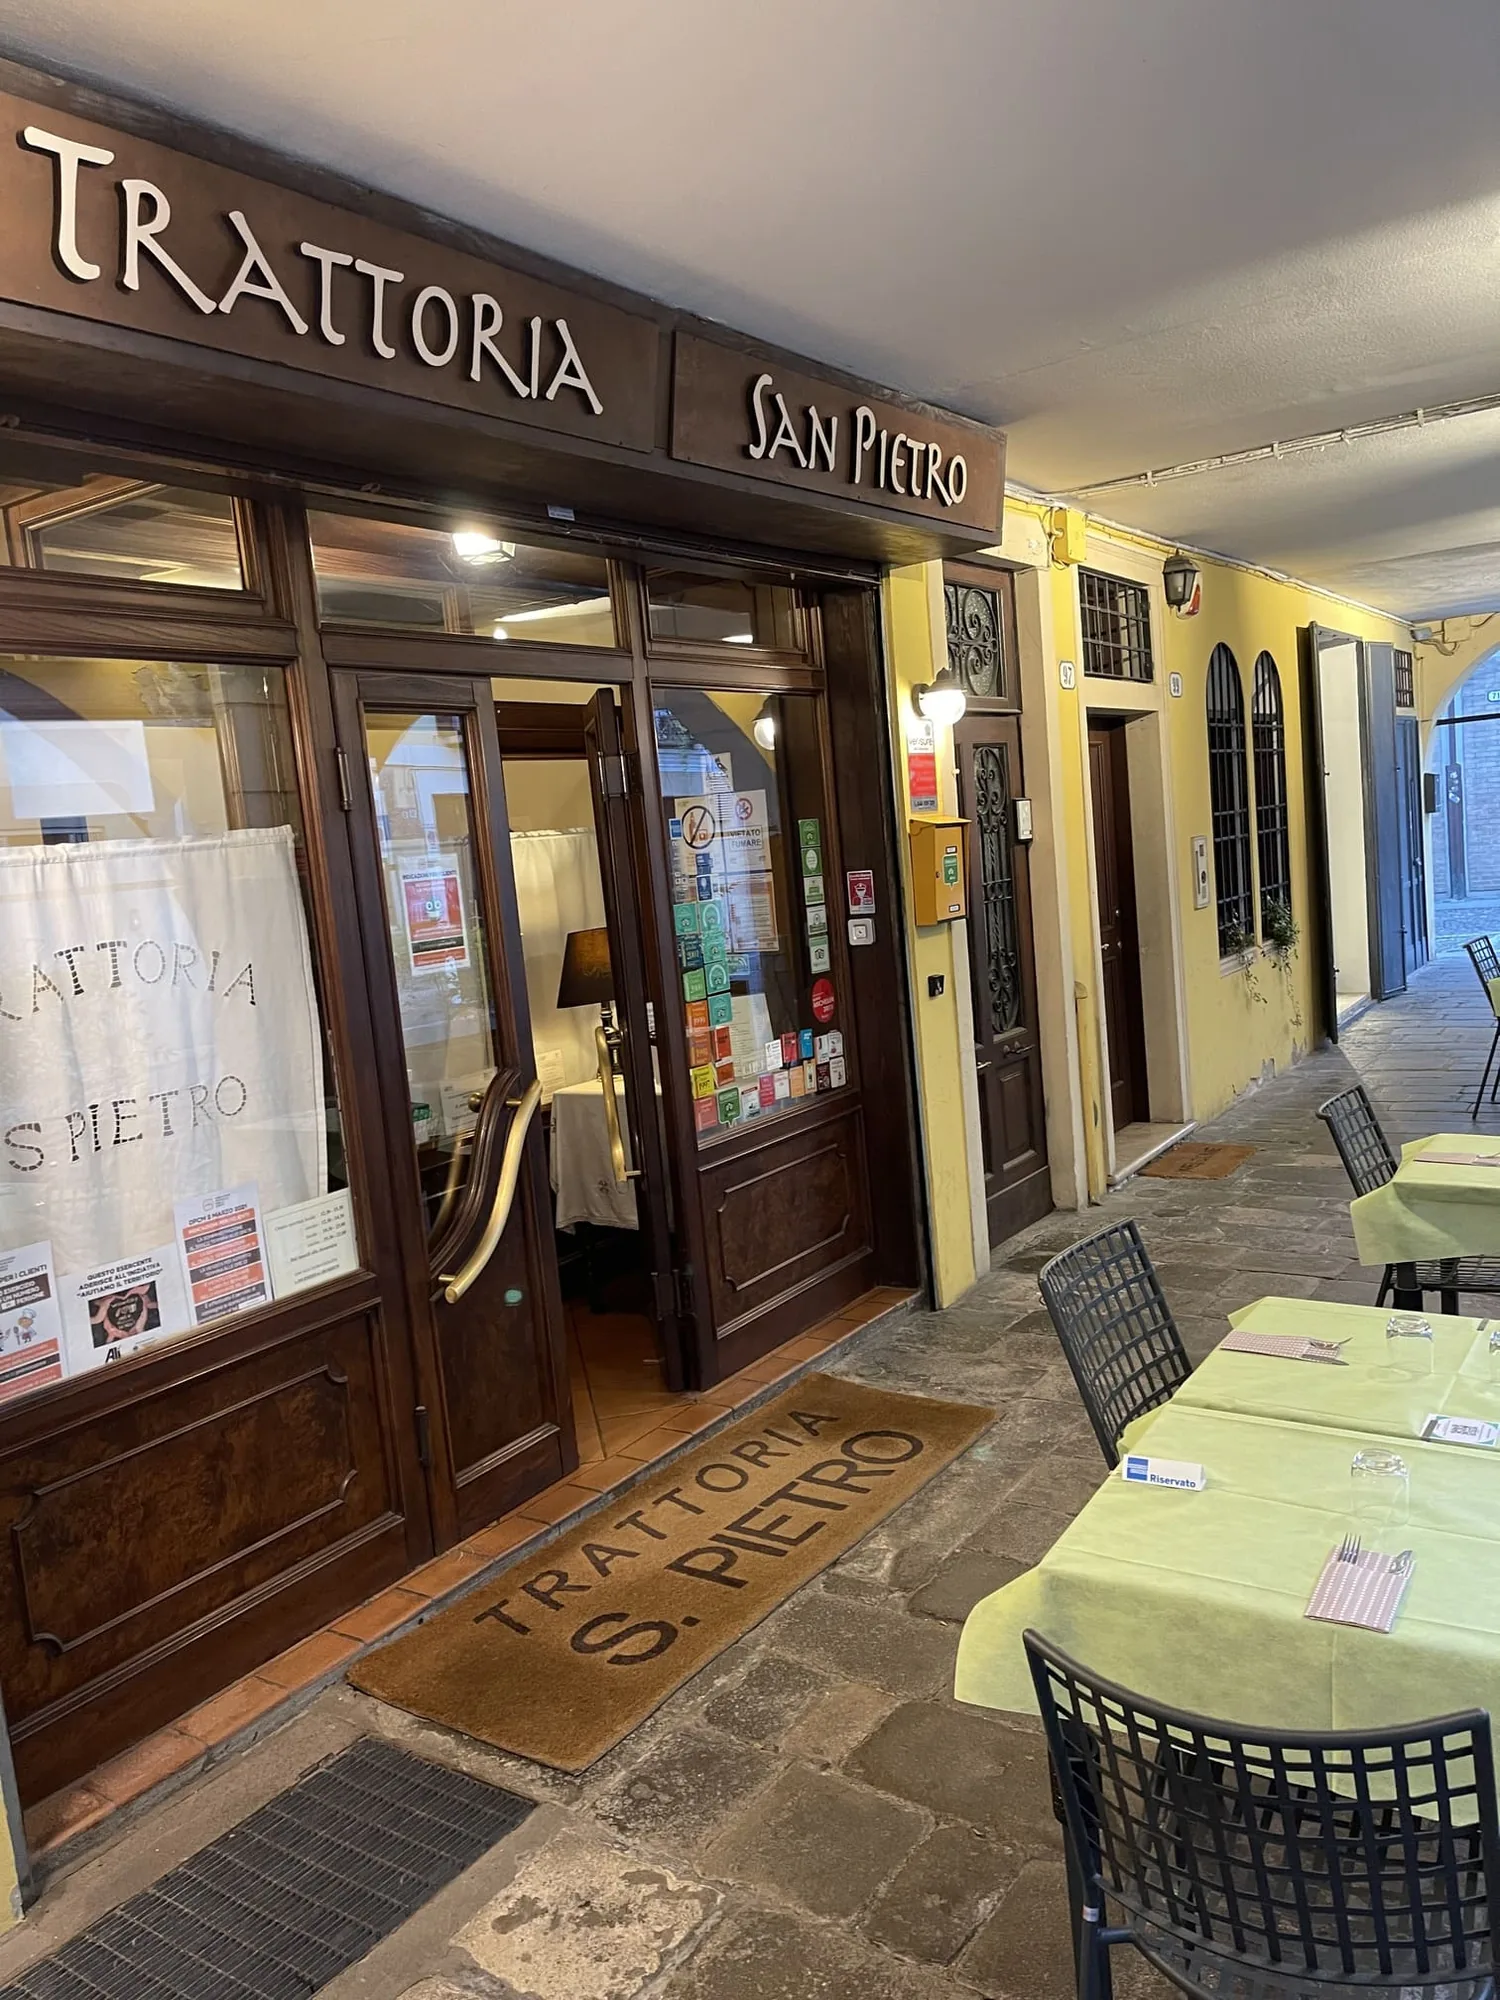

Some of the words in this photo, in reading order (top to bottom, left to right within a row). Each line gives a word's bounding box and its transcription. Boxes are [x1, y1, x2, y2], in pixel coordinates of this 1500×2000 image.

[22, 126, 604, 415] TRATTORIA
[749, 373, 838, 473] SAN
[855, 405, 968, 507] PIETRO
[731, 838, 762, 848] FUMARE
[5, 1122, 45, 1172] S
[64, 1075, 247, 1163] PIETRO
[212, 1208, 234, 1217] MARZO
[18, 1264, 47, 1279] CLIENTI
[87, 1268, 115, 1281] QUESTO
[116, 1257, 152, 1273] ESERCENTE
[78, 1275, 113, 1291] ADERISCE
[1150, 1474, 1196, 1488] Riservato
[474, 1408, 841, 1637] TRATTORIA
[570, 1611, 701, 1666] S.
[664, 1429, 924, 1589] PIETRO
